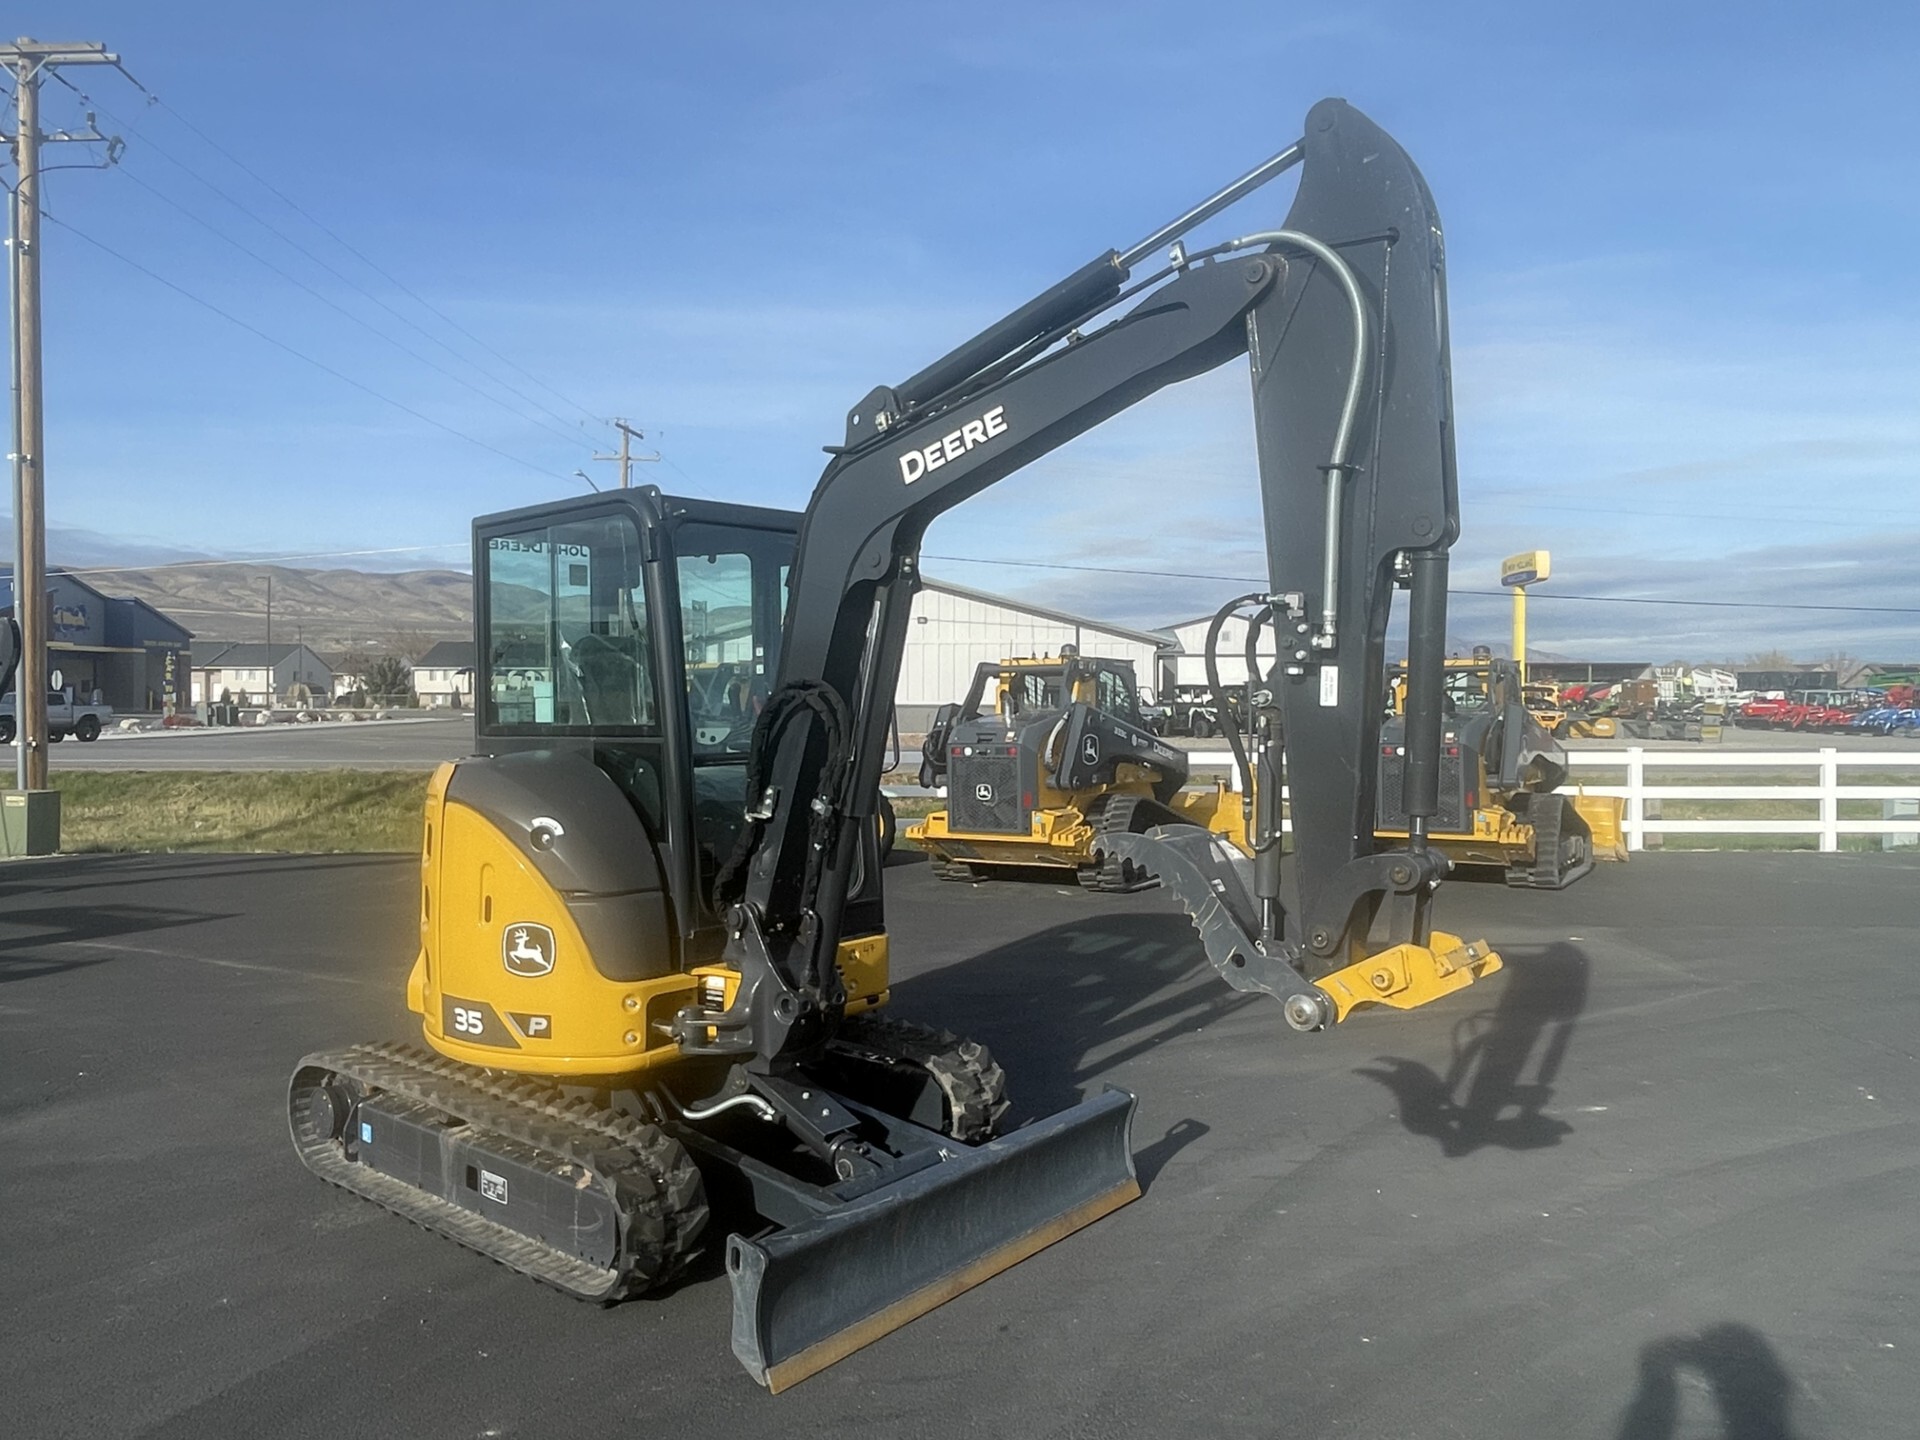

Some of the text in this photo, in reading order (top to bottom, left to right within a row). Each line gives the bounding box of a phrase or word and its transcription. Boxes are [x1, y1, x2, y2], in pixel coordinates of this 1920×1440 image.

[898, 405, 1008, 485] DEERE
[1153, 741, 1175, 761] DEERE
[453, 1007, 548, 1035] 35 P
